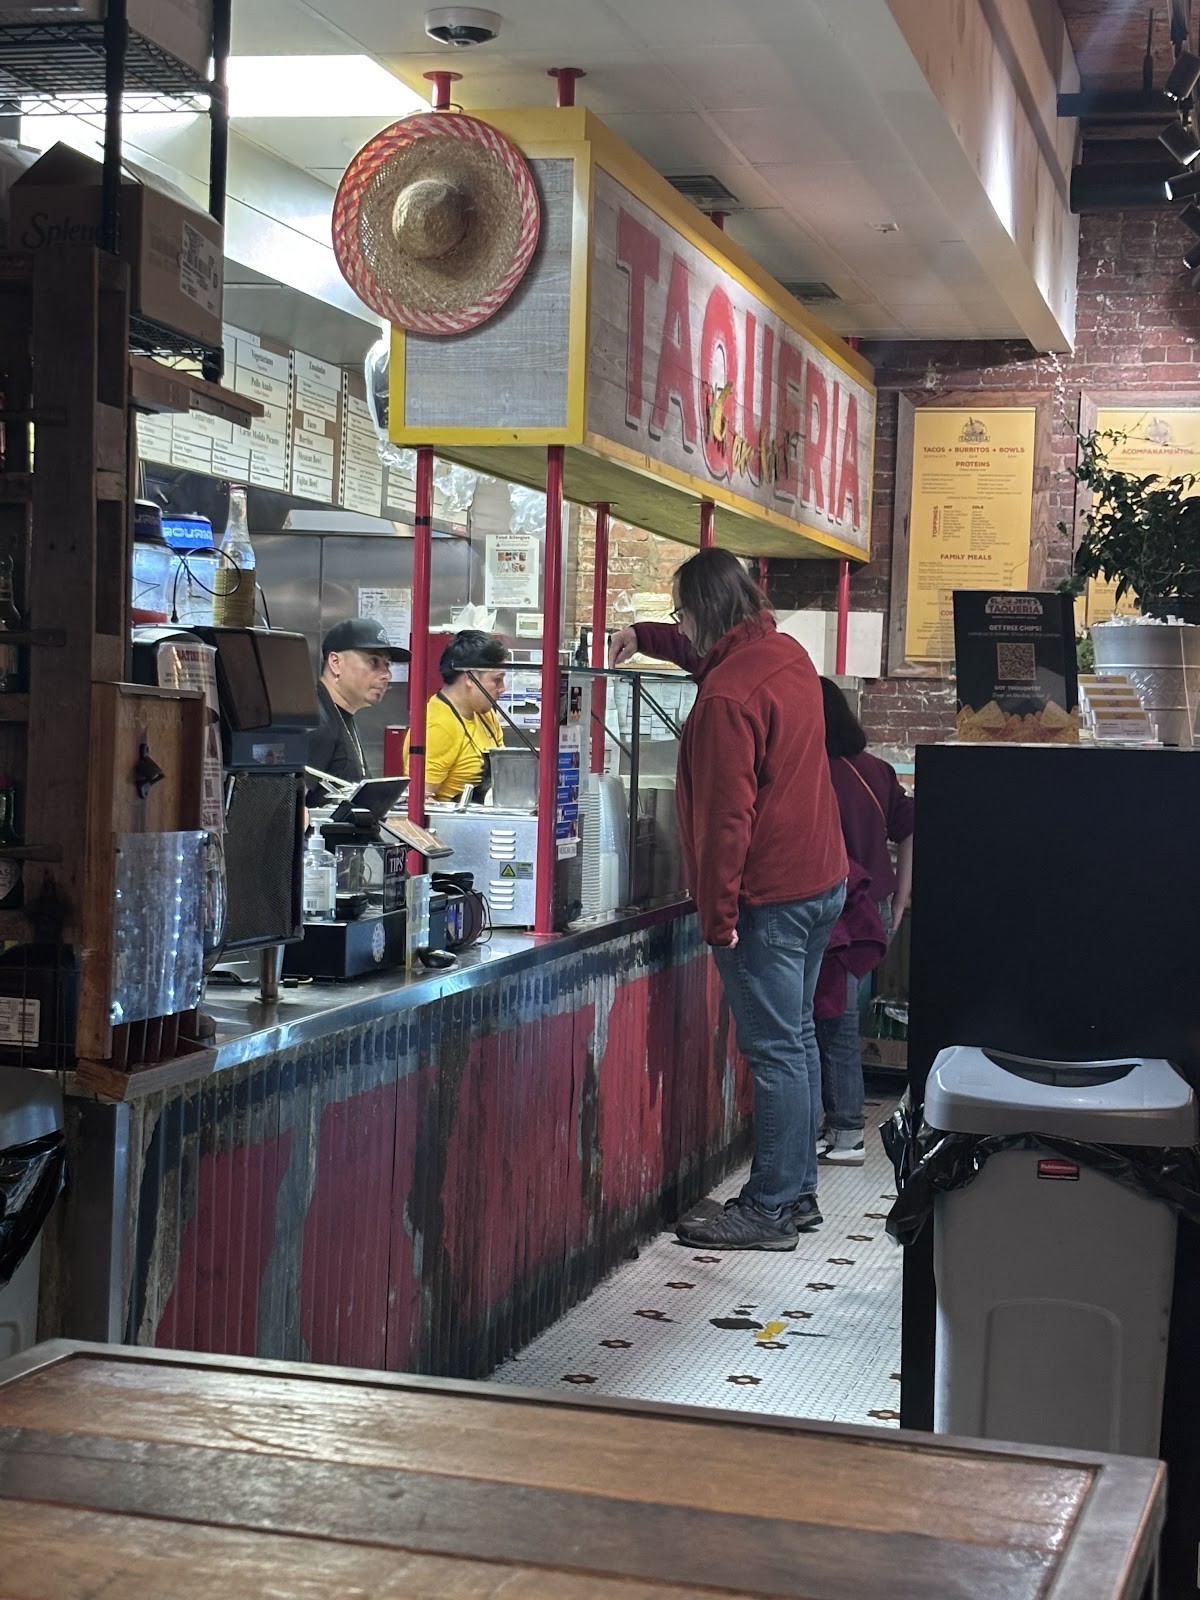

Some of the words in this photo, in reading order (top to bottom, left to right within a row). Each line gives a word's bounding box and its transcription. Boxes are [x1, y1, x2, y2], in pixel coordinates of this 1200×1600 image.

[616, 207, 862, 533] TAQUERIA
[987, 604, 1041, 614] TAQUERIA
[1019, 624, 1042, 632] CHIPS!
[389, 857, 404, 873] TIPS
